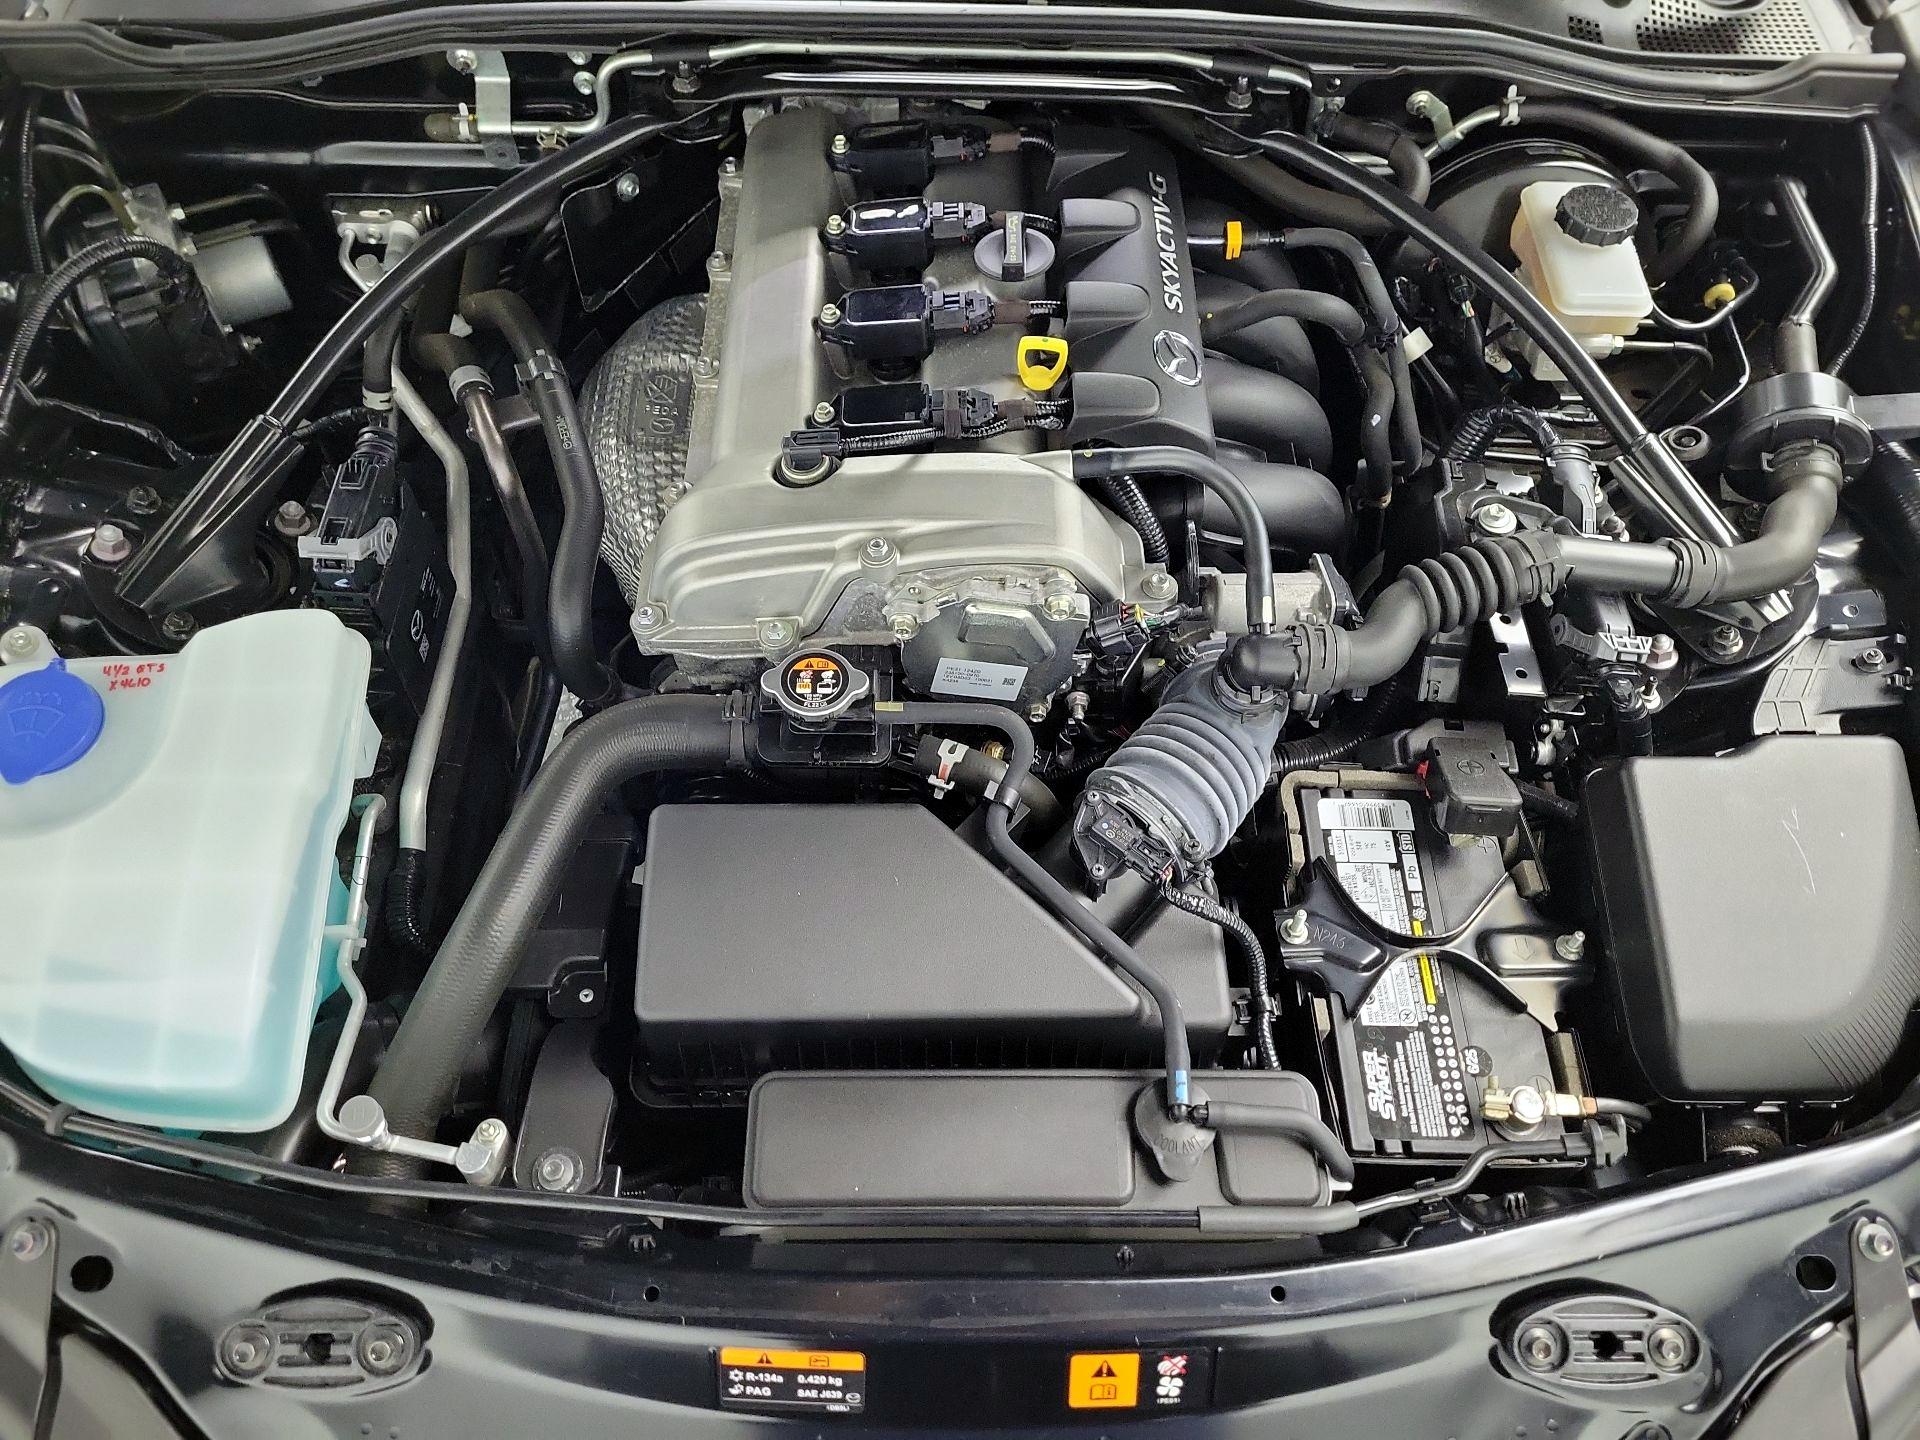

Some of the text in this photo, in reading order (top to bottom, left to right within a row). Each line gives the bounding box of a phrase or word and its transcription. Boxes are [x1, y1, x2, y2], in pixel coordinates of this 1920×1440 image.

[1149, 171, 1184, 314] SKYACTIV-G
[1407, 865, 1418, 880] Pb
[1464, 1048, 1480, 1075] 6/25
[1362, 1049, 1379, 1112] SUPER
[1376, 1055, 1397, 1122] START
[1154, 1133, 1202, 1154] COOLANT
[745, 1371, 843, 1387] R-134a 0.420 kg
[745, 1385, 843, 1399] PAG SAE J639
